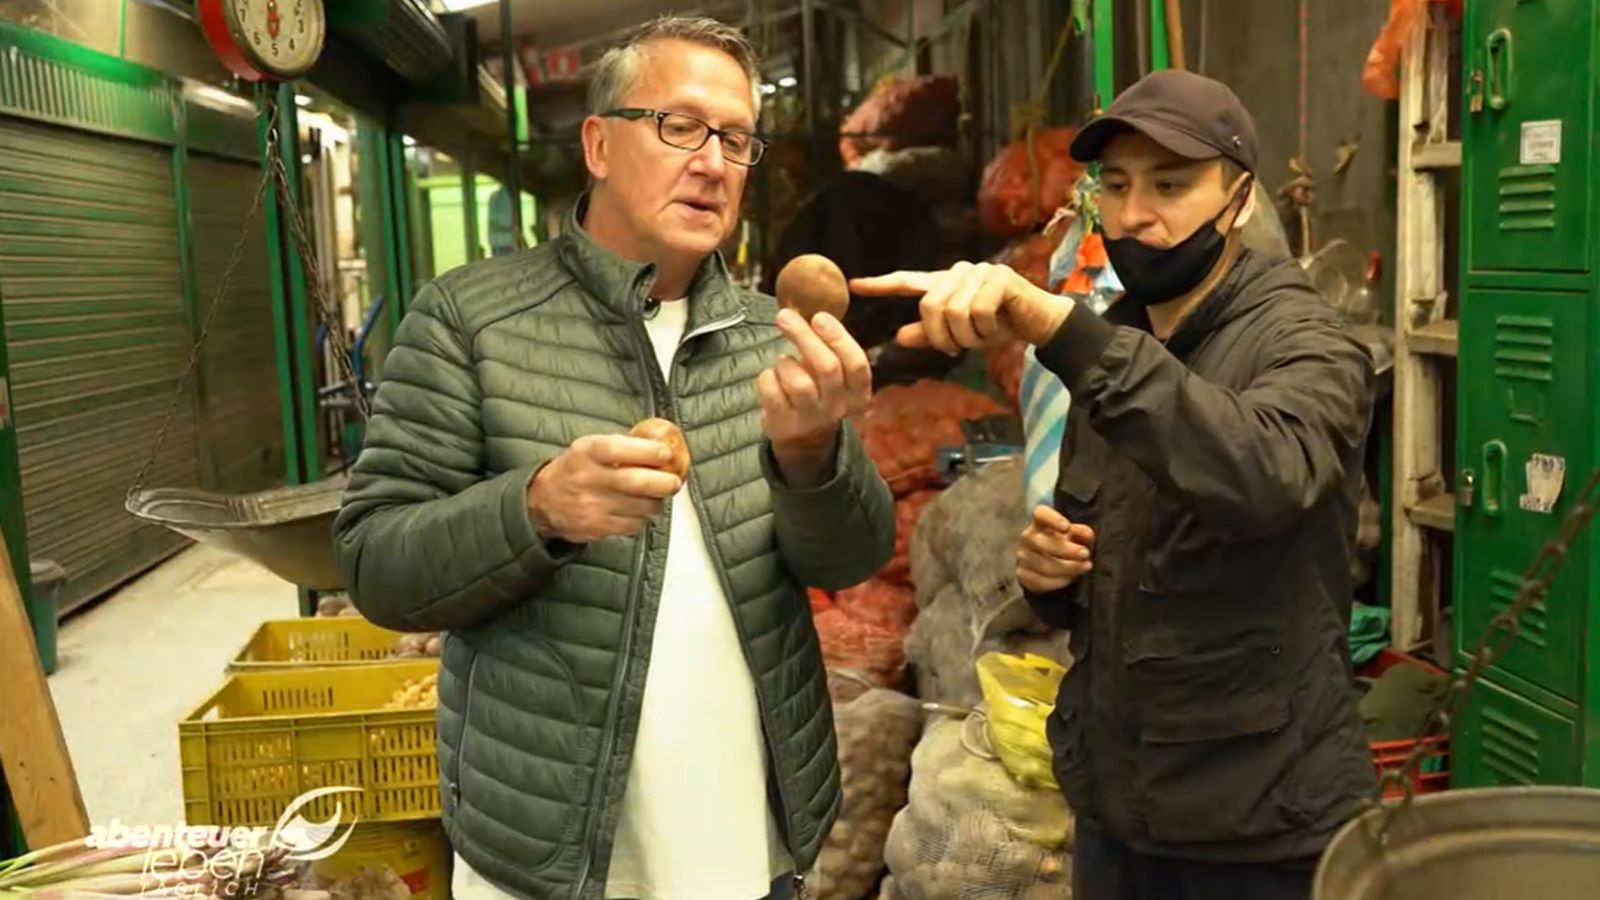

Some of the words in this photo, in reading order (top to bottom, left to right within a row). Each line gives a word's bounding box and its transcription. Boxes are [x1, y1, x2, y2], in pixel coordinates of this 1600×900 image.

[239, 8, 246, 22] 7
[253, 31, 261, 45] 6
[288, 38, 295, 50] 4
[271, 42, 279, 57] 5
